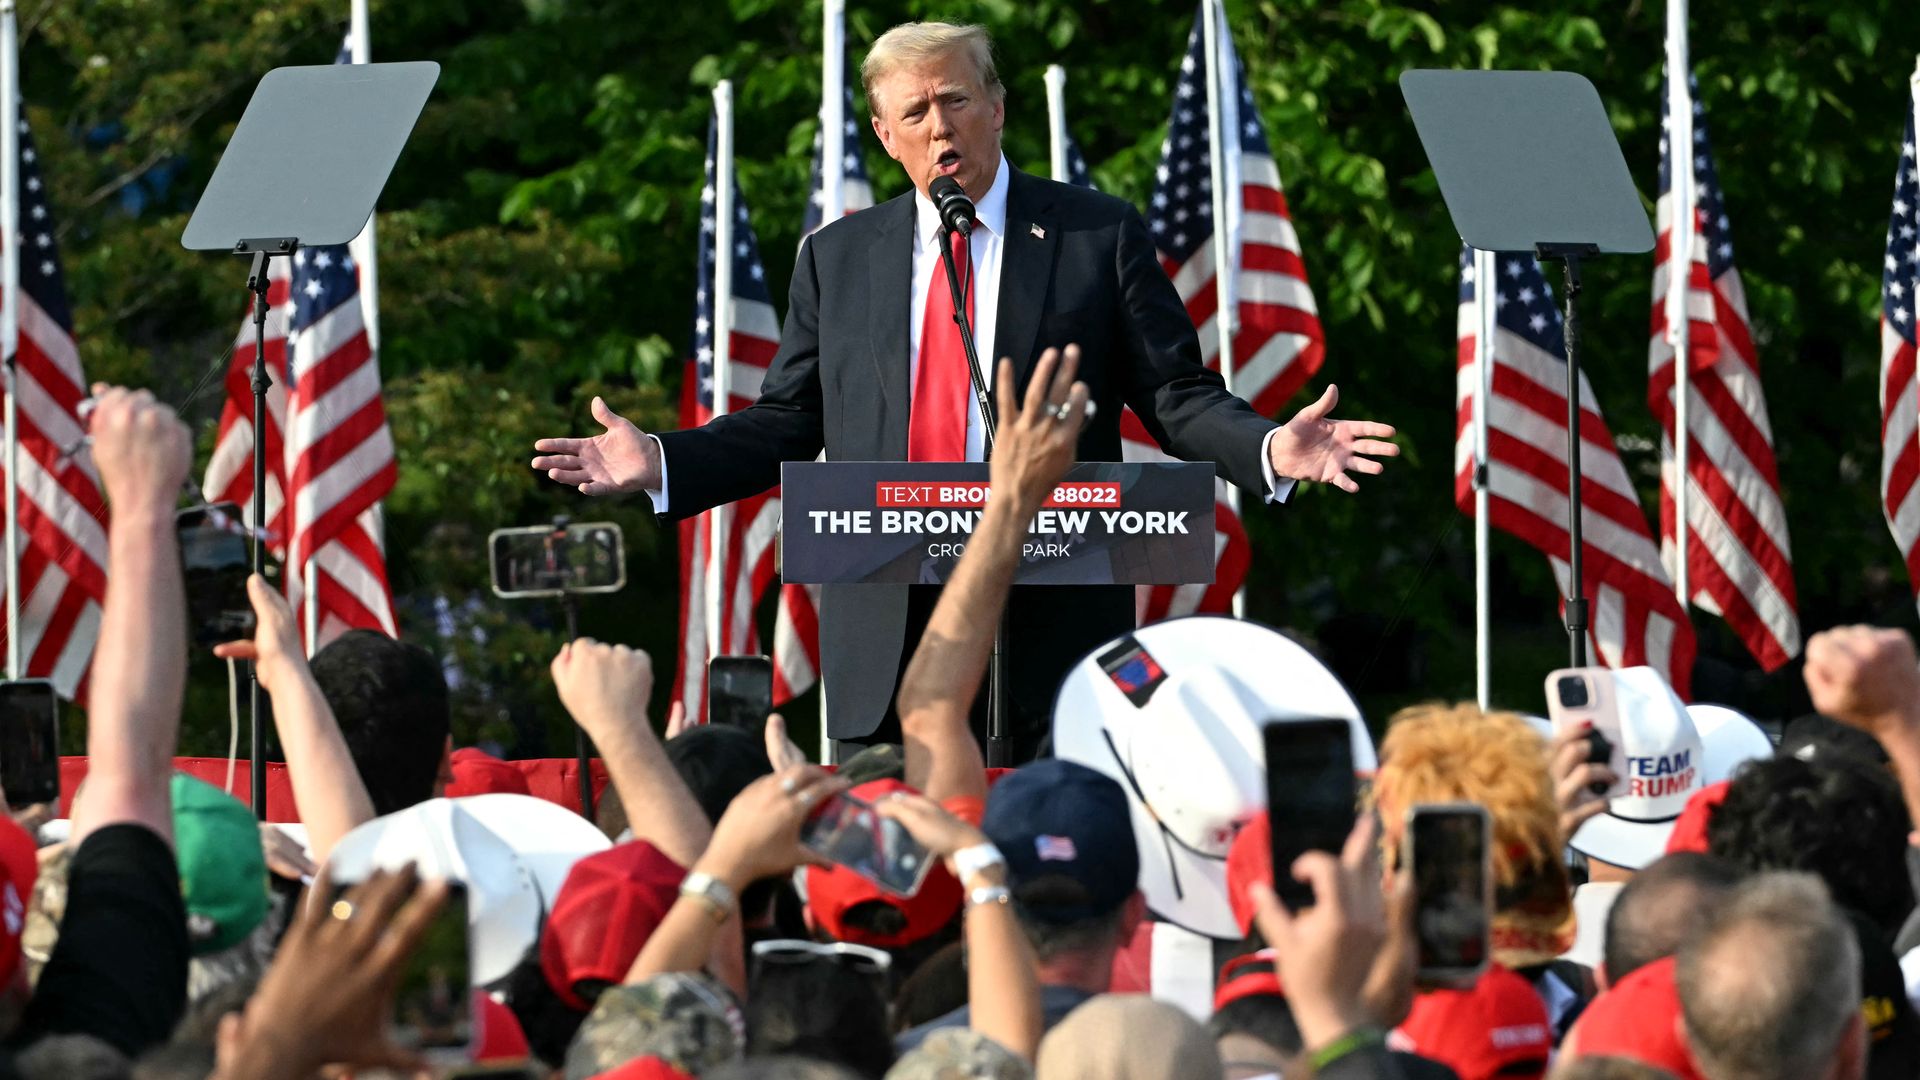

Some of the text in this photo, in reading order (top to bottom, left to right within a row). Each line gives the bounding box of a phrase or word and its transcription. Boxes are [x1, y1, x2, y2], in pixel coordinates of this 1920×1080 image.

[881, 486, 933, 503] TEXT
[1053, 486, 1117, 503] 88022
[808, 510, 872, 534] THE
[881, 510, 984, 534] BRON
[1099, 510, 1189, 534] YORK
[1022, 543, 1071, 558] PARK
[1627, 766, 1696, 797] RUMP
